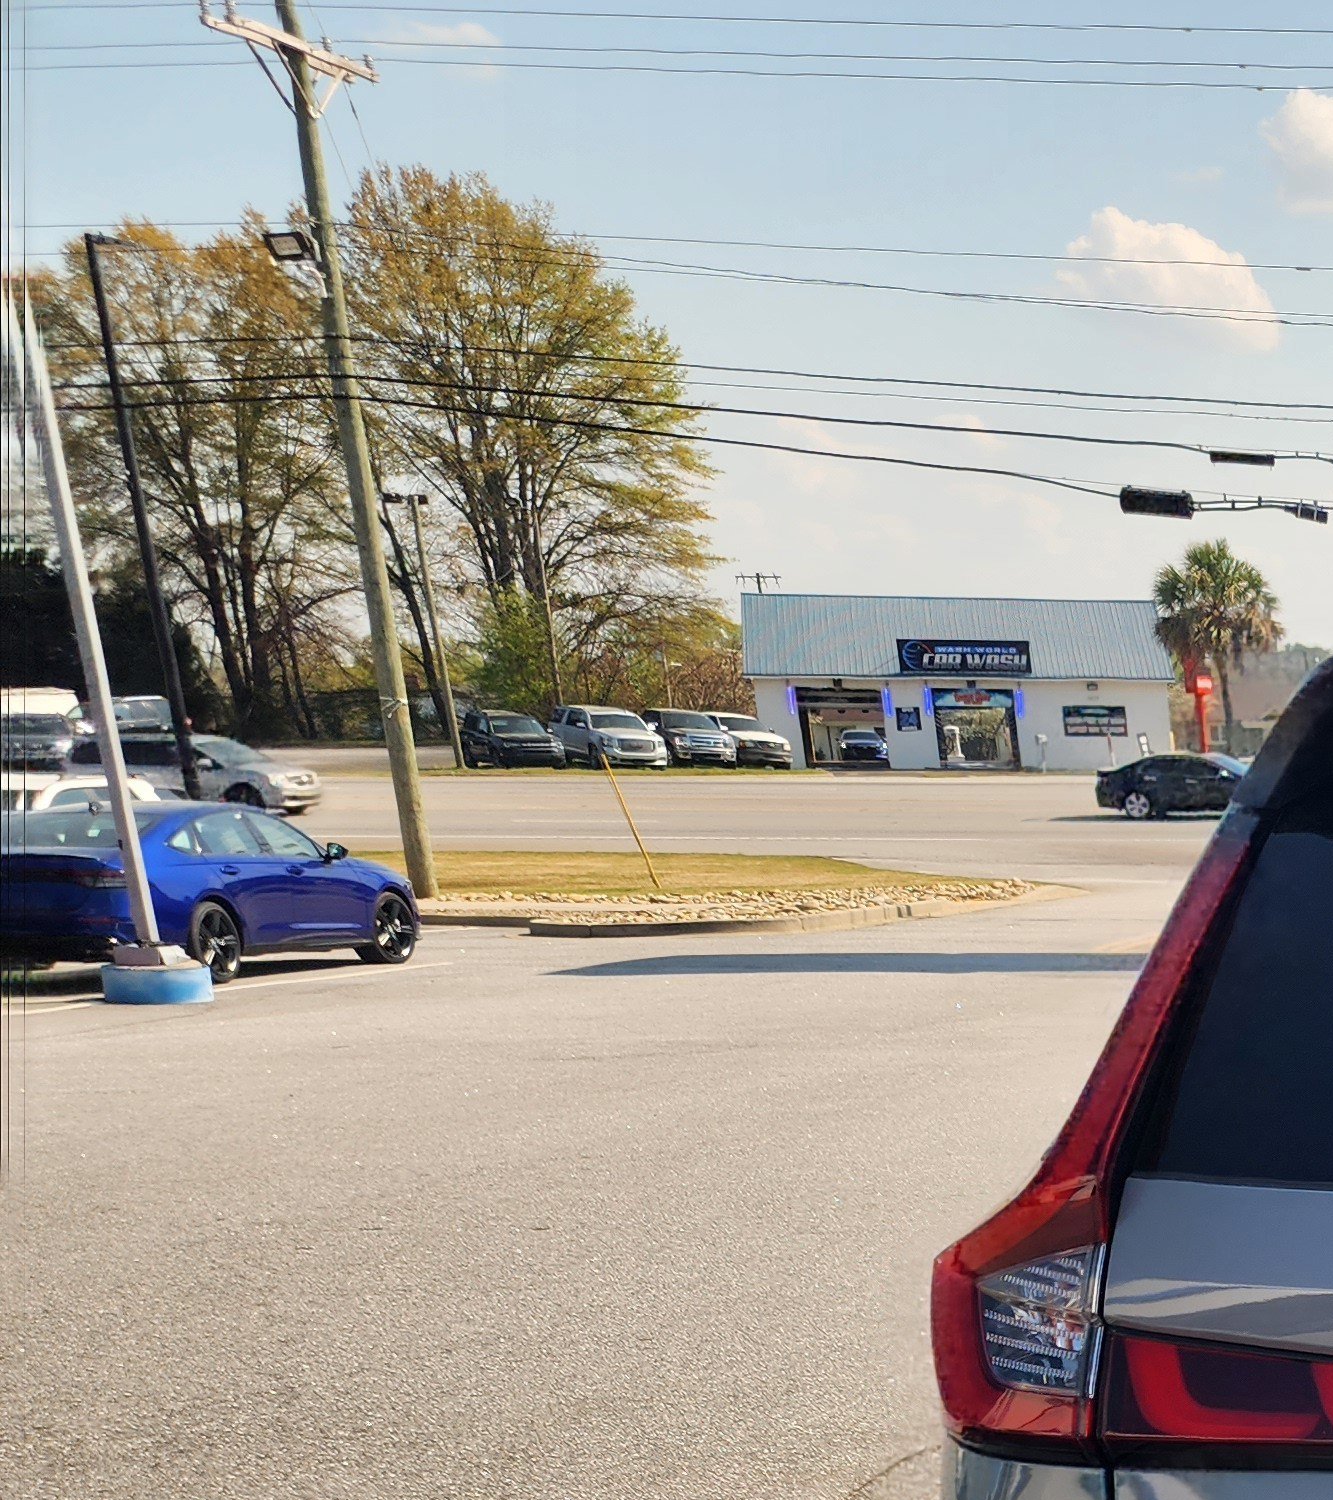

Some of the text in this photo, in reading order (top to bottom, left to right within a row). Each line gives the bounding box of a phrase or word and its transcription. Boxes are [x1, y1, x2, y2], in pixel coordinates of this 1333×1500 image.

[975, 646, 1017, 654] WORLD
[922, 653, 1027, 670] CAR WASH
